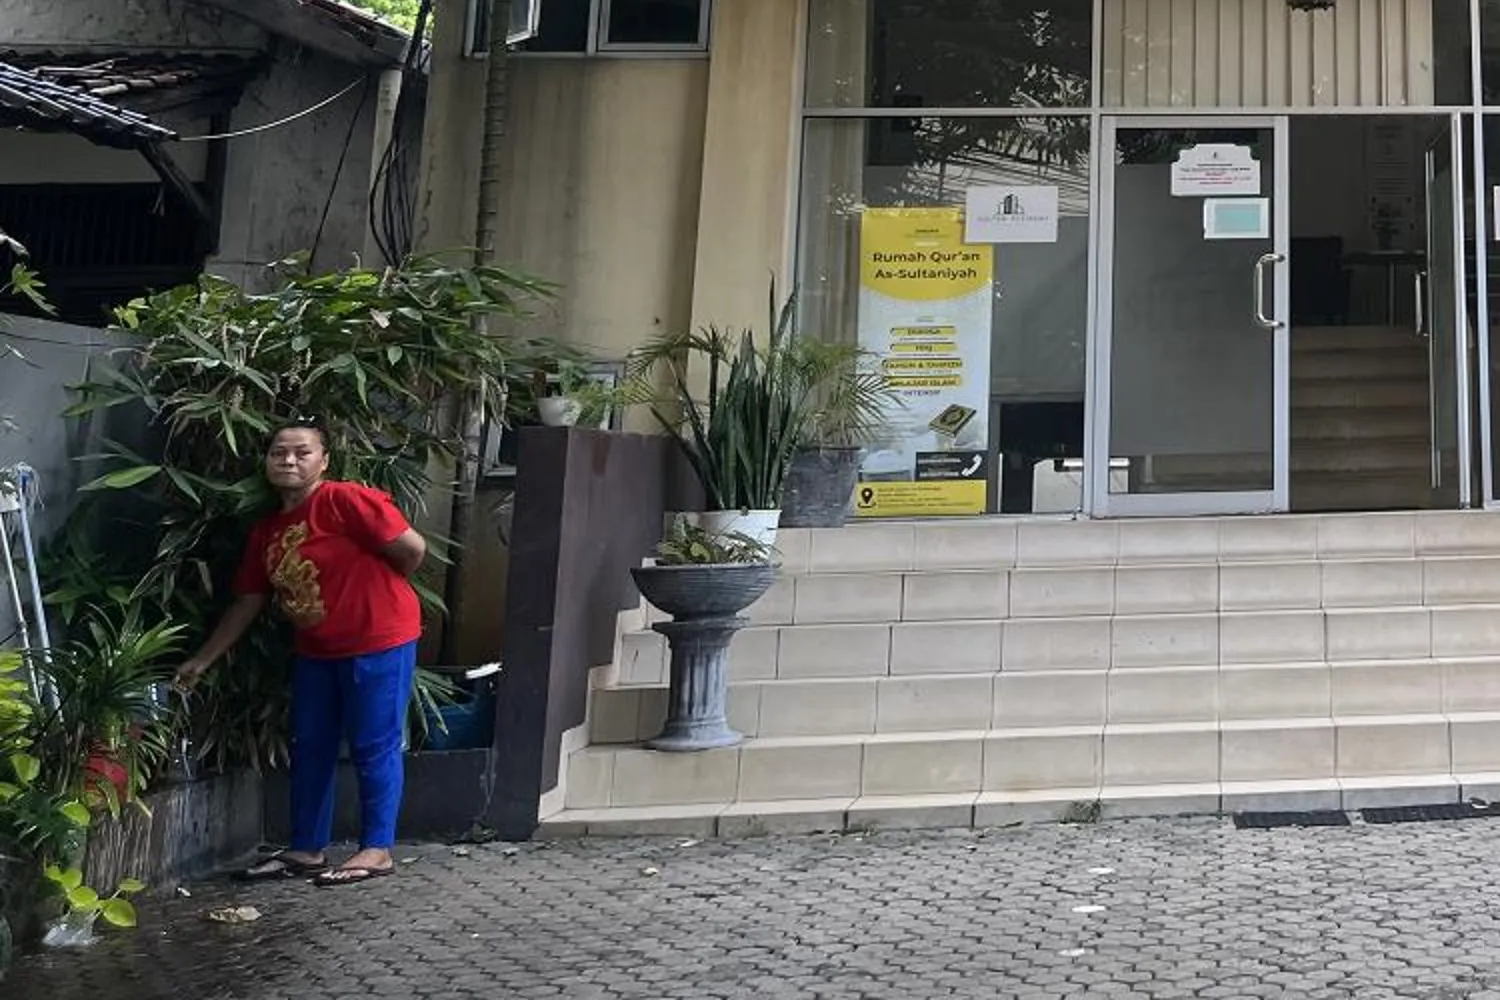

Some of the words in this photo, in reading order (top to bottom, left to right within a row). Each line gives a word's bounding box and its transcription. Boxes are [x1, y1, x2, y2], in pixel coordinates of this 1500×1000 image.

[873, 251, 928, 263] Rumah
[930, 250, 981, 263] Qur'an
[875, 267, 978, 281] As-Sultaniyah
